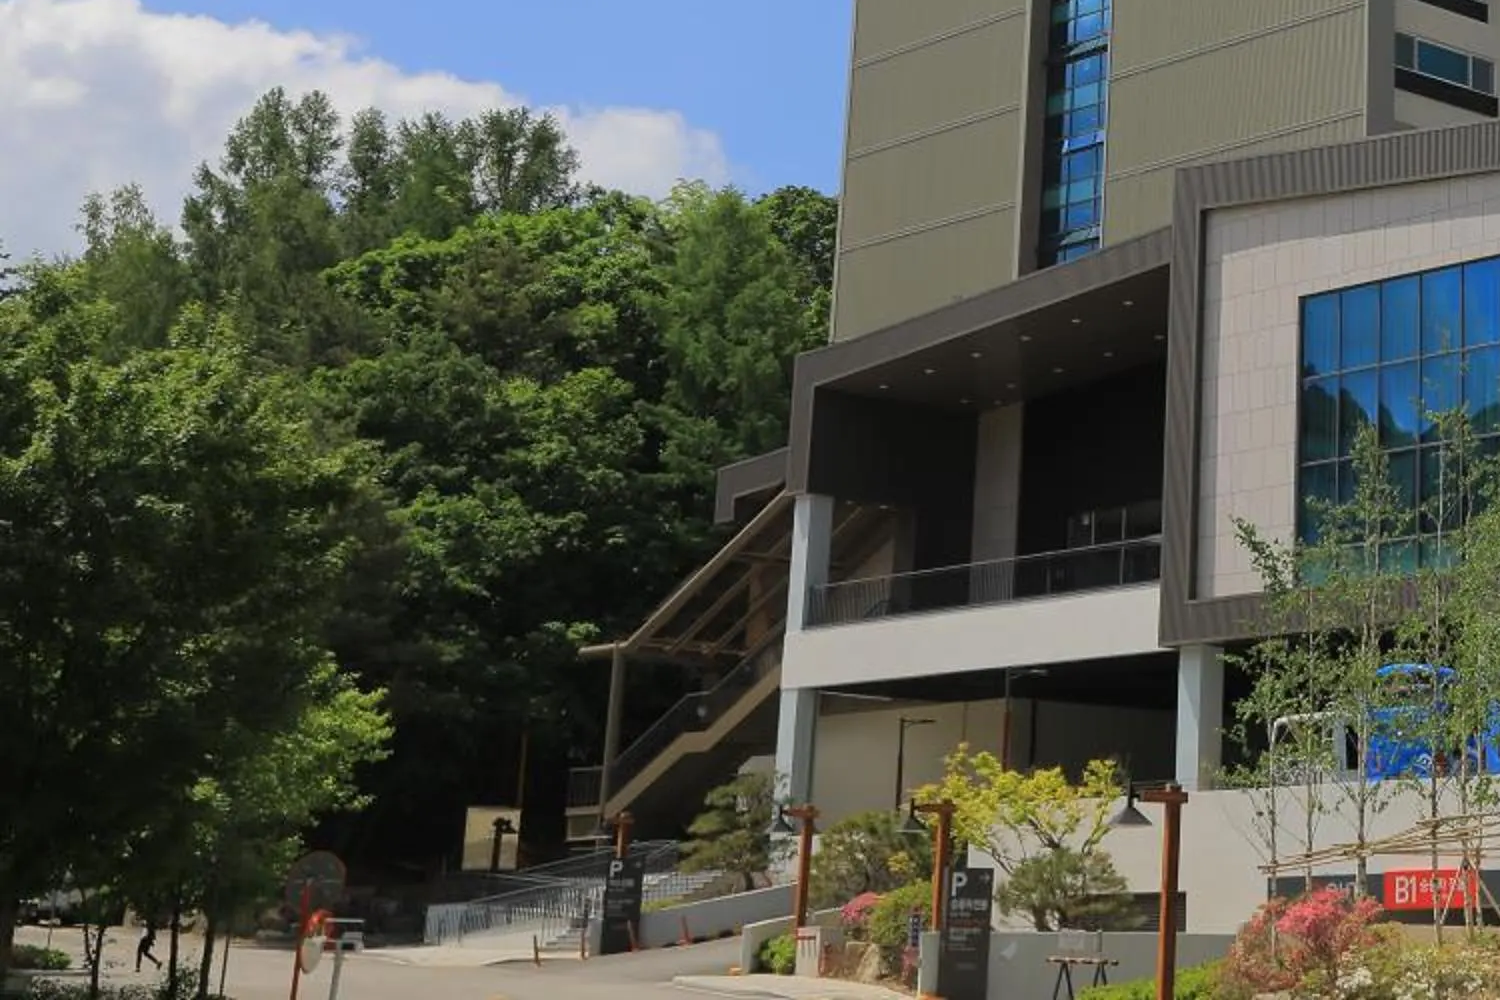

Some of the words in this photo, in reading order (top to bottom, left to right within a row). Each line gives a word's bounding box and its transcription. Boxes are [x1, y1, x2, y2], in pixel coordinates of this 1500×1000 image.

[610, 861, 623, 878] P
[952, 872, 968, 897] P
[1395, 877, 1417, 904] B1
